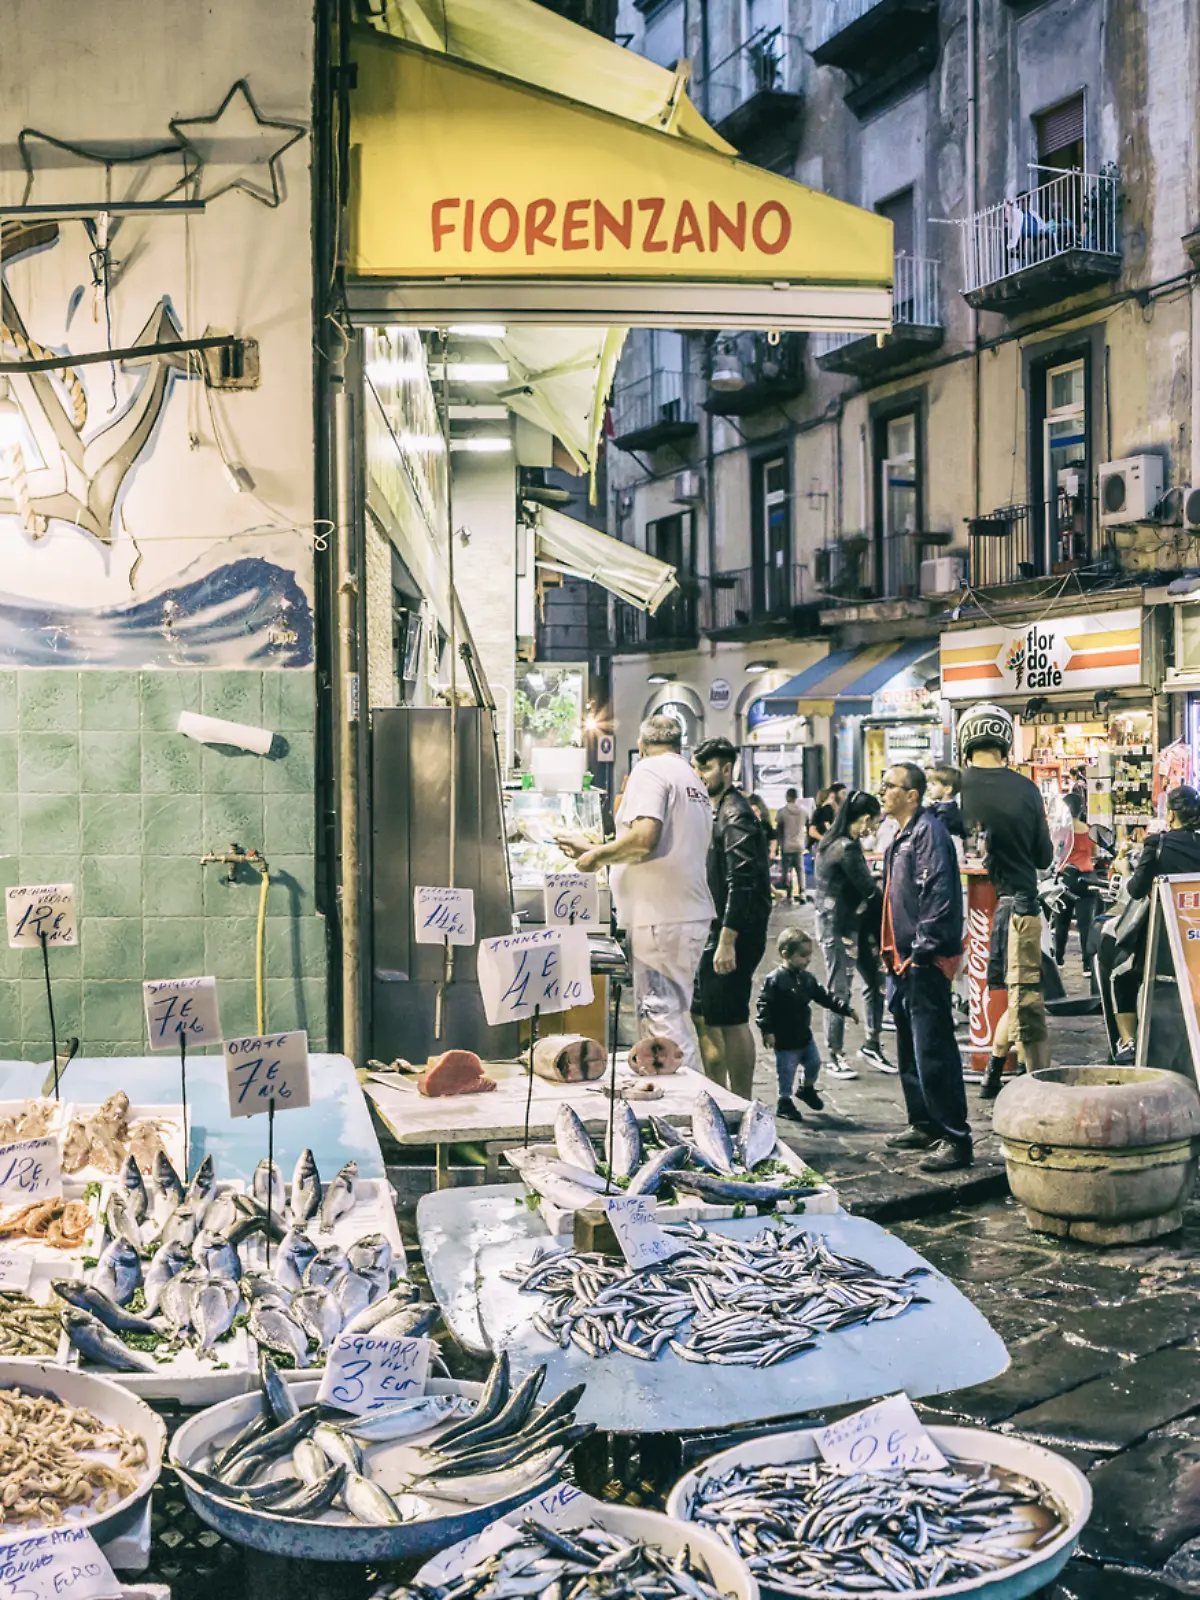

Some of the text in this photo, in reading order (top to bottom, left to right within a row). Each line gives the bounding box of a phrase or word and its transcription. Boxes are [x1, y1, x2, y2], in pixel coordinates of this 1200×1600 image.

[431, 197, 792, 255] FIORENZANO
[1026, 625, 1056, 650] flor
[1027, 650, 1048, 670] do
[153, 996, 179, 1037] 7
[229, 1035, 288, 1055] ORATE
[234, 1058, 264, 1104] 7
[332, 1359, 372, 1403] 3
